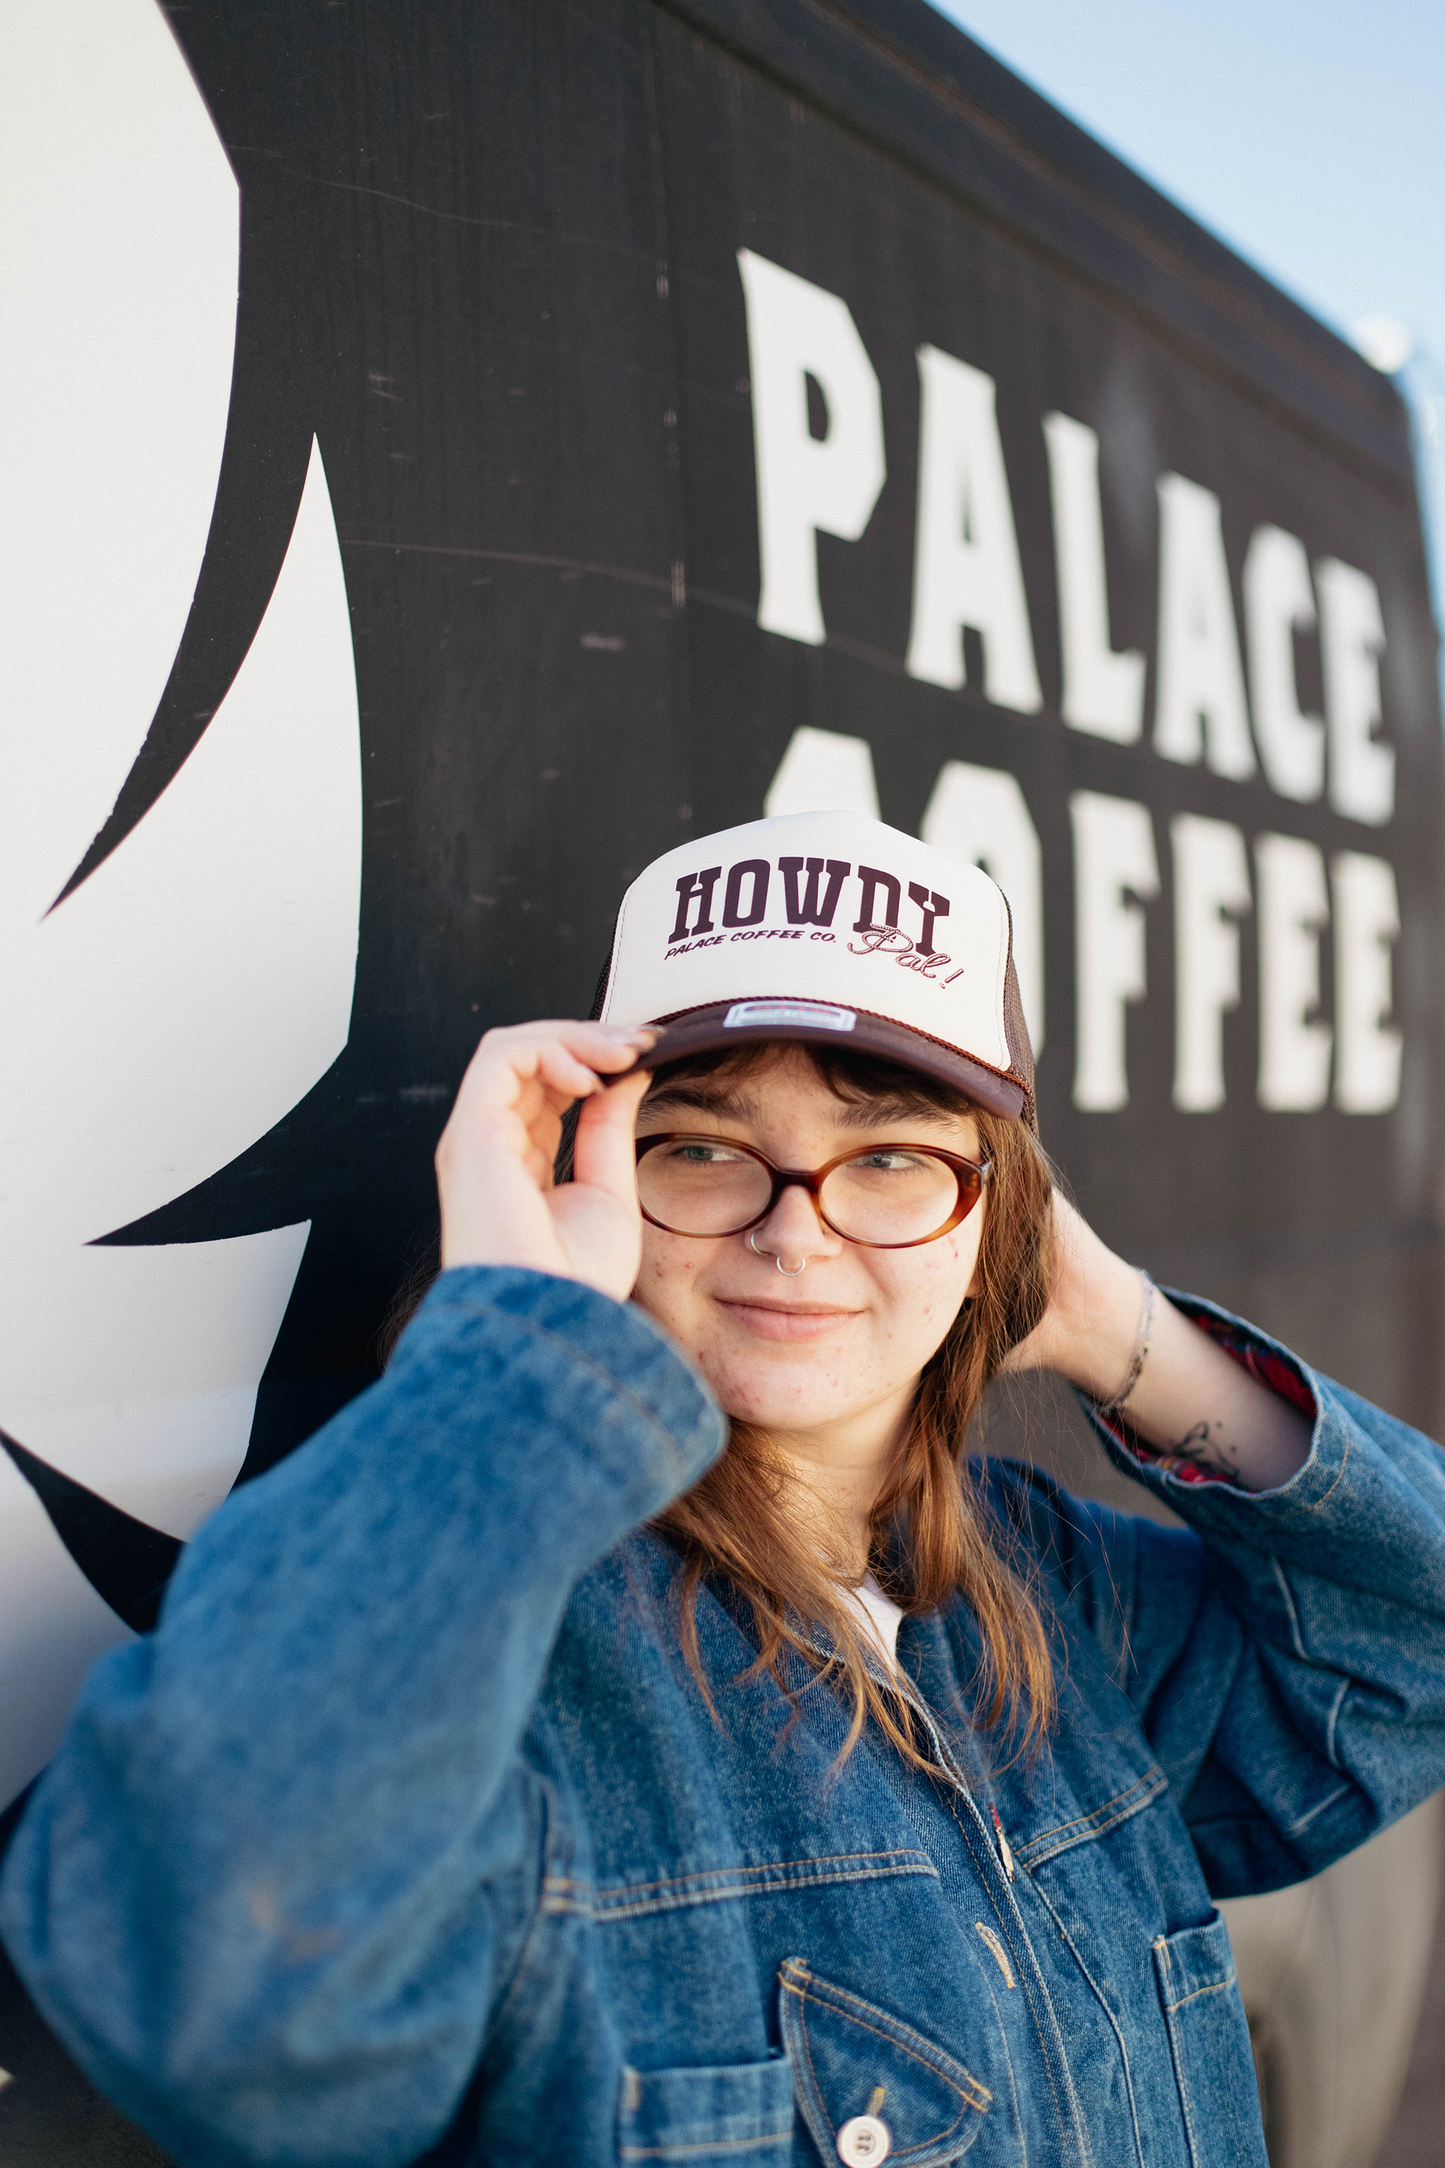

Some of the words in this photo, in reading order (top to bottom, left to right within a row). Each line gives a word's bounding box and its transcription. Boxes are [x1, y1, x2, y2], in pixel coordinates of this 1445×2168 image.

[737, 248, 1396, 825] PALACE
[664, 934, 726, 960] PALACE
[730, 929, 805, 942] COFFEE
[810, 931, 836, 943] CO.
[668, 856, 950, 957] HOWDY
[764, 727, 1403, 1114] FFEE
